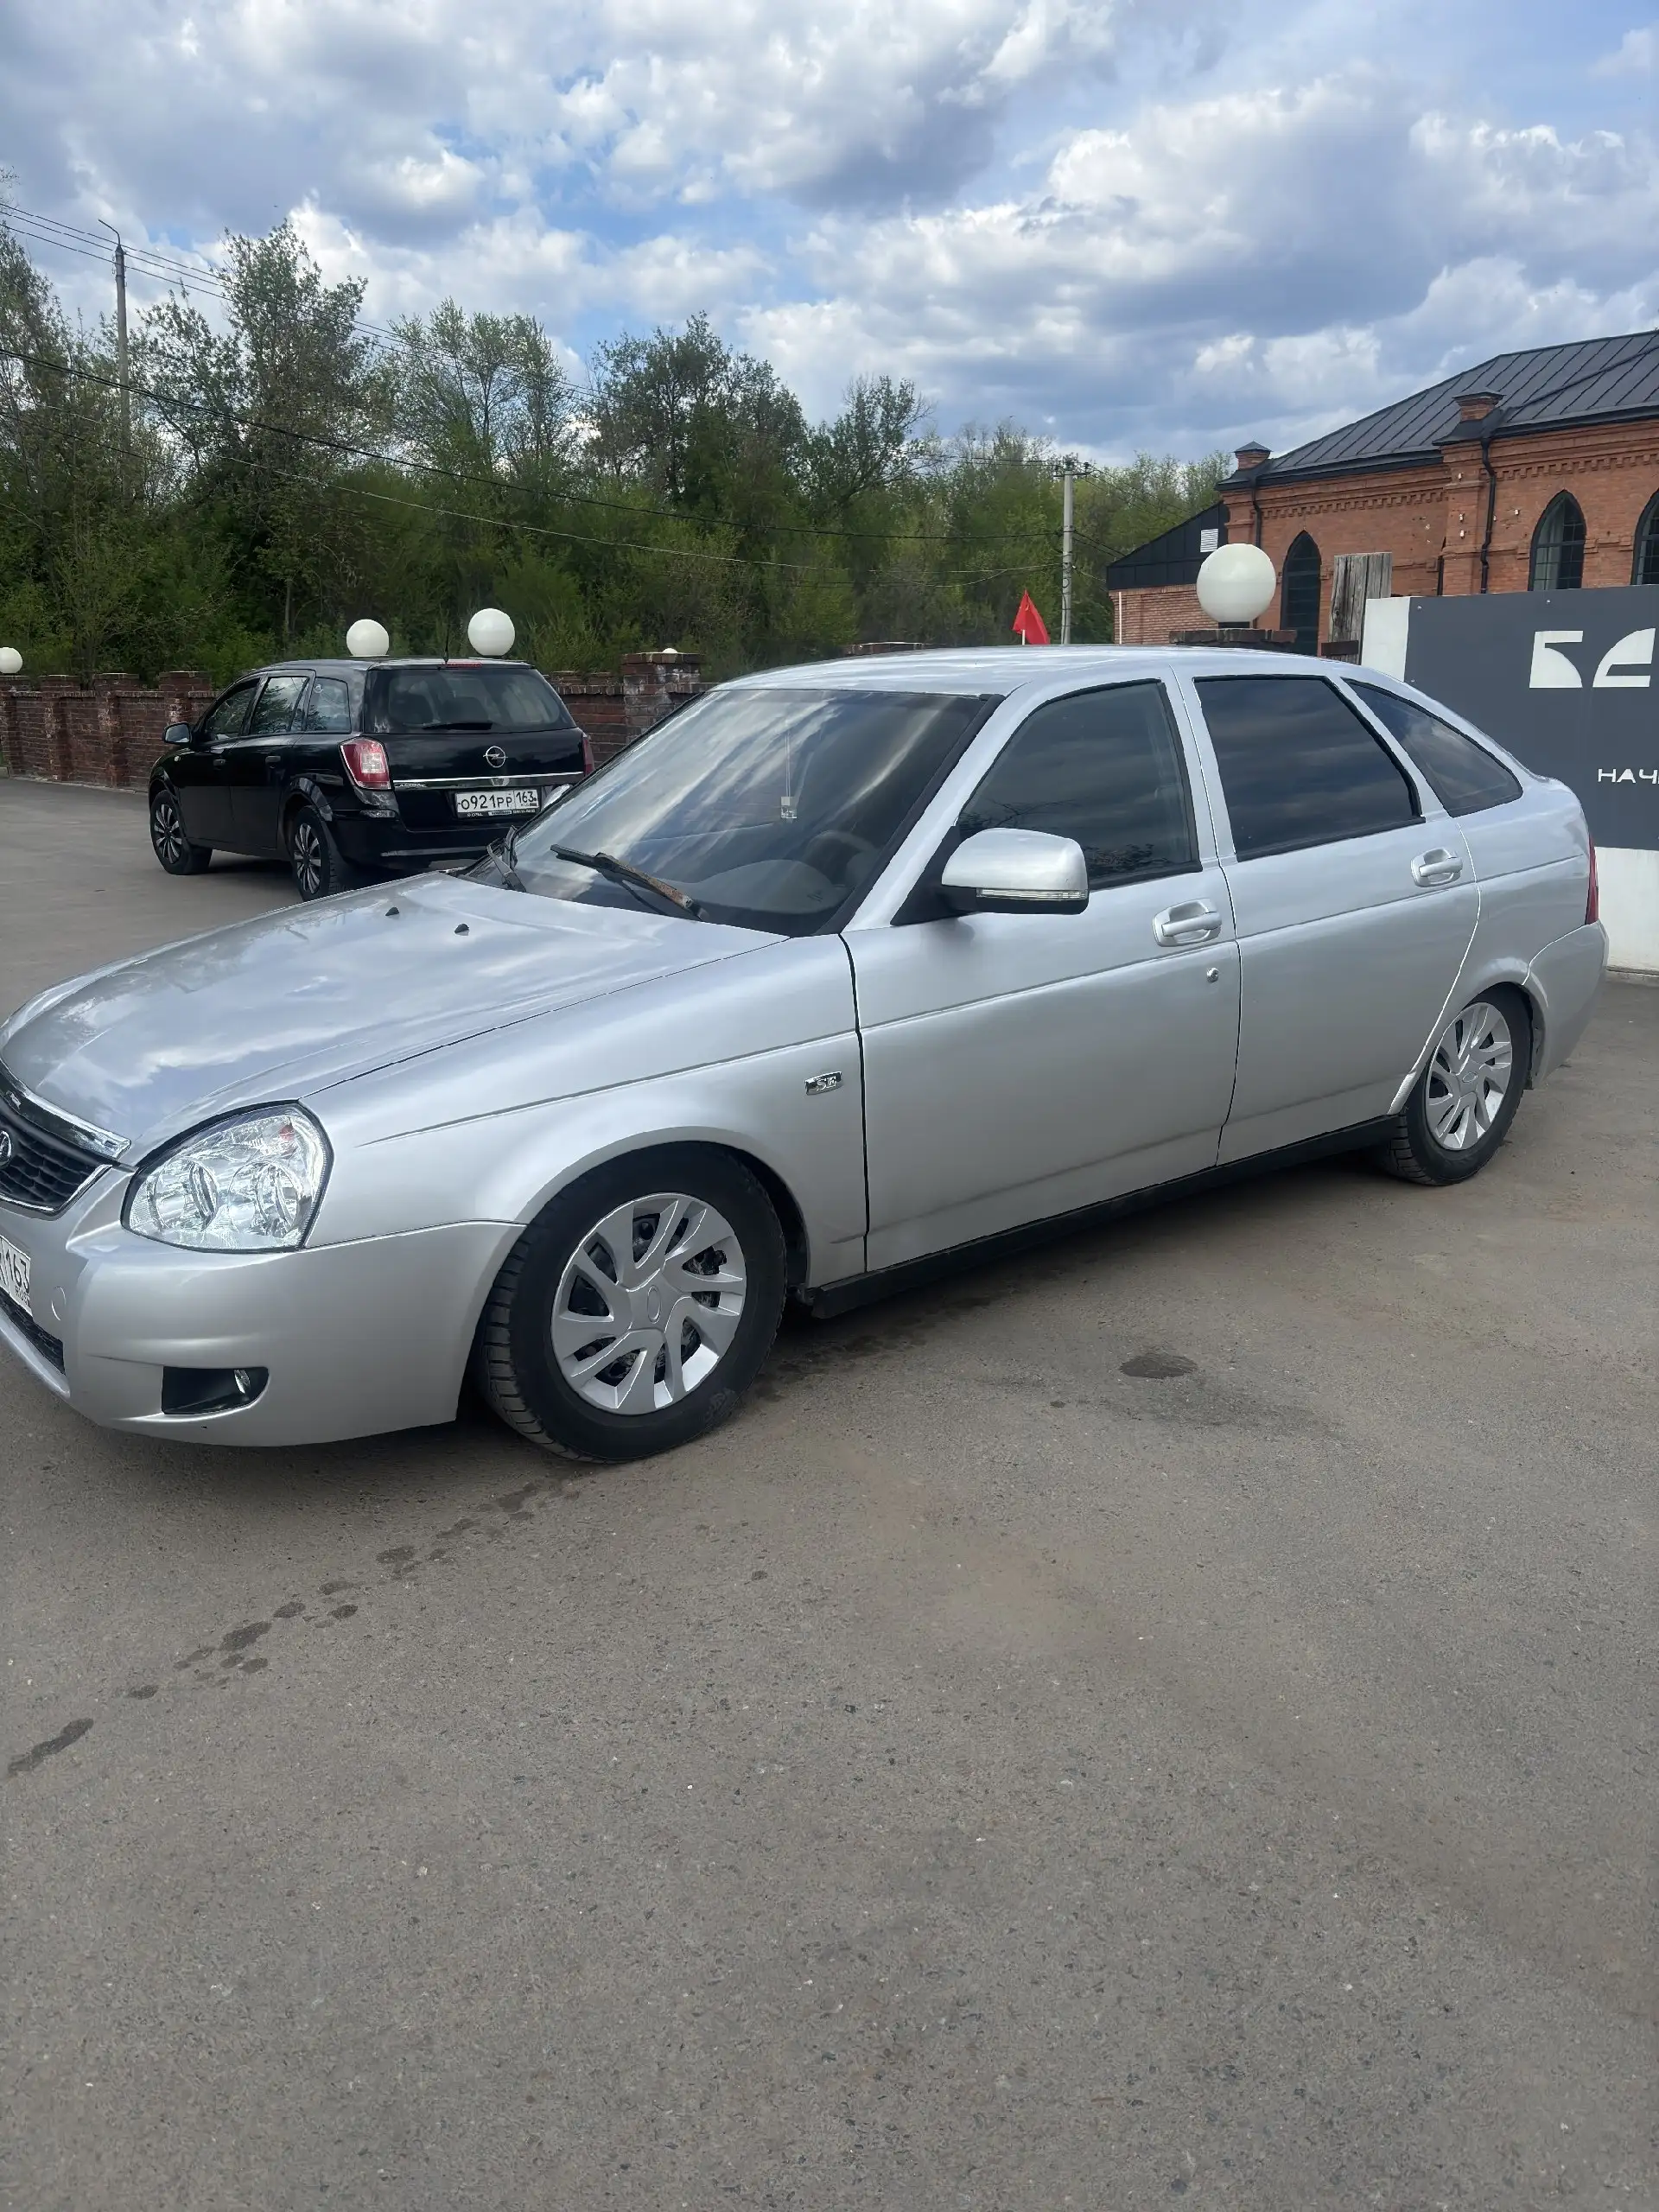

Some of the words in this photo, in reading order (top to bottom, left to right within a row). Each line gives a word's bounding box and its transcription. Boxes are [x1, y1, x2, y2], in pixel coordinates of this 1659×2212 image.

[1598, 768, 1659, 785] НАЧ
[516, 791, 534, 804] 163
[5, 1248, 29, 1294] 163
